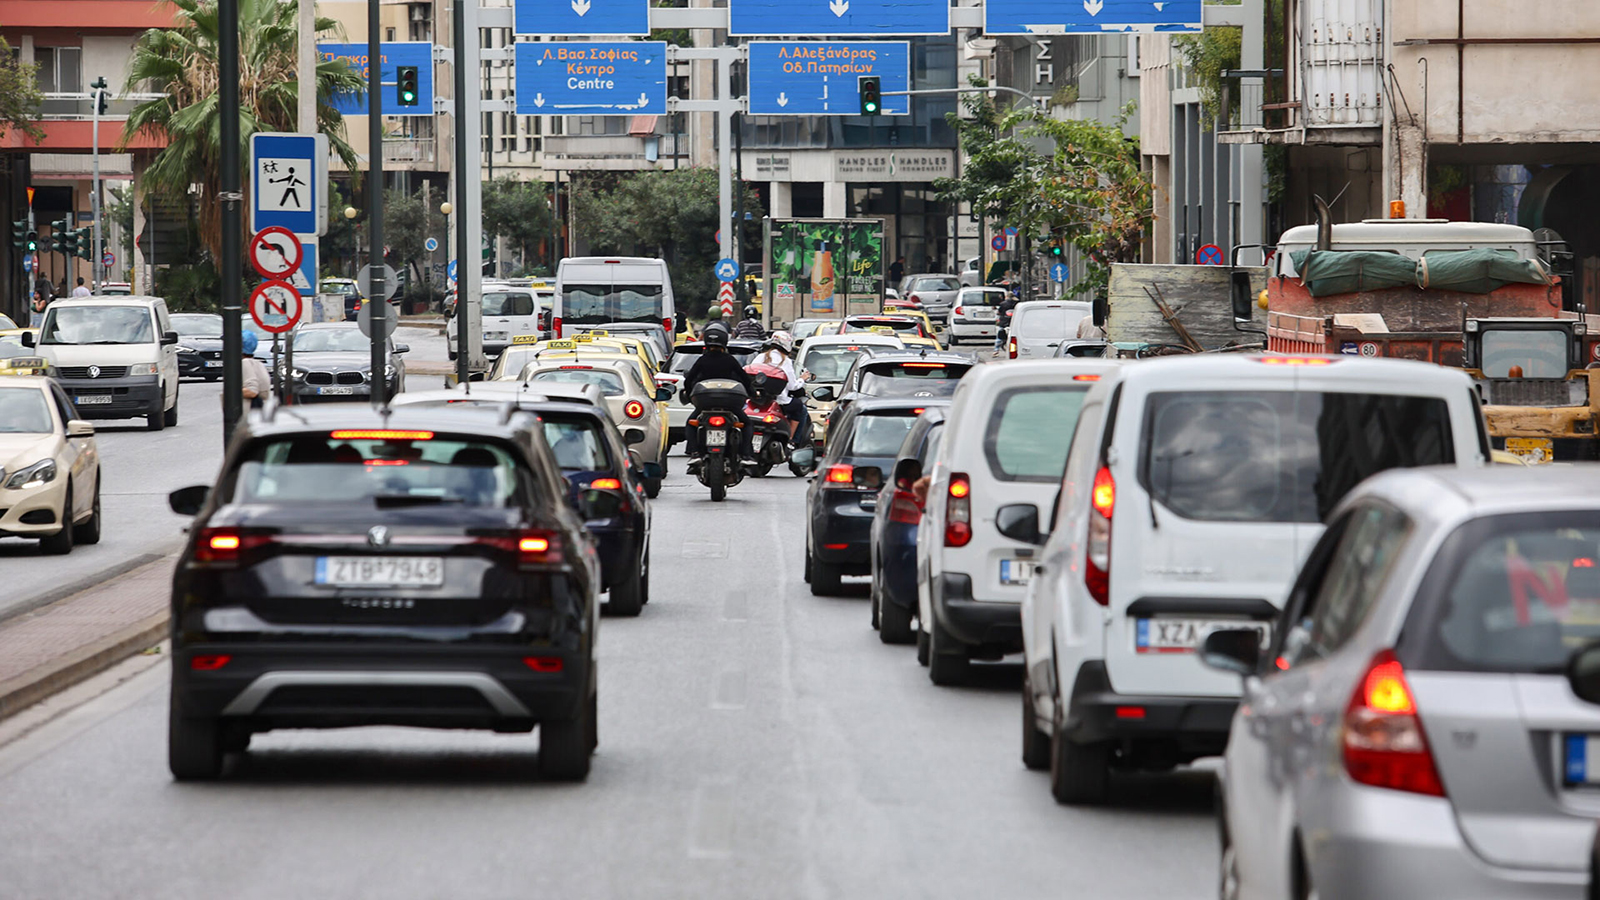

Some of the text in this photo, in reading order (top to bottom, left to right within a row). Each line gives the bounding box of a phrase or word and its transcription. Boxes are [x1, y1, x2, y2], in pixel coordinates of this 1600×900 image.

[567, 62, 615, 77] Κέντρο
[567, 77, 615, 90] Centre
[839, 157, 947, 166] HANDLES HANDLES
[853, 258, 873, 274] Life
[1363, 345, 1375, 355] 80
[14, 359, 41, 367] TAXI
